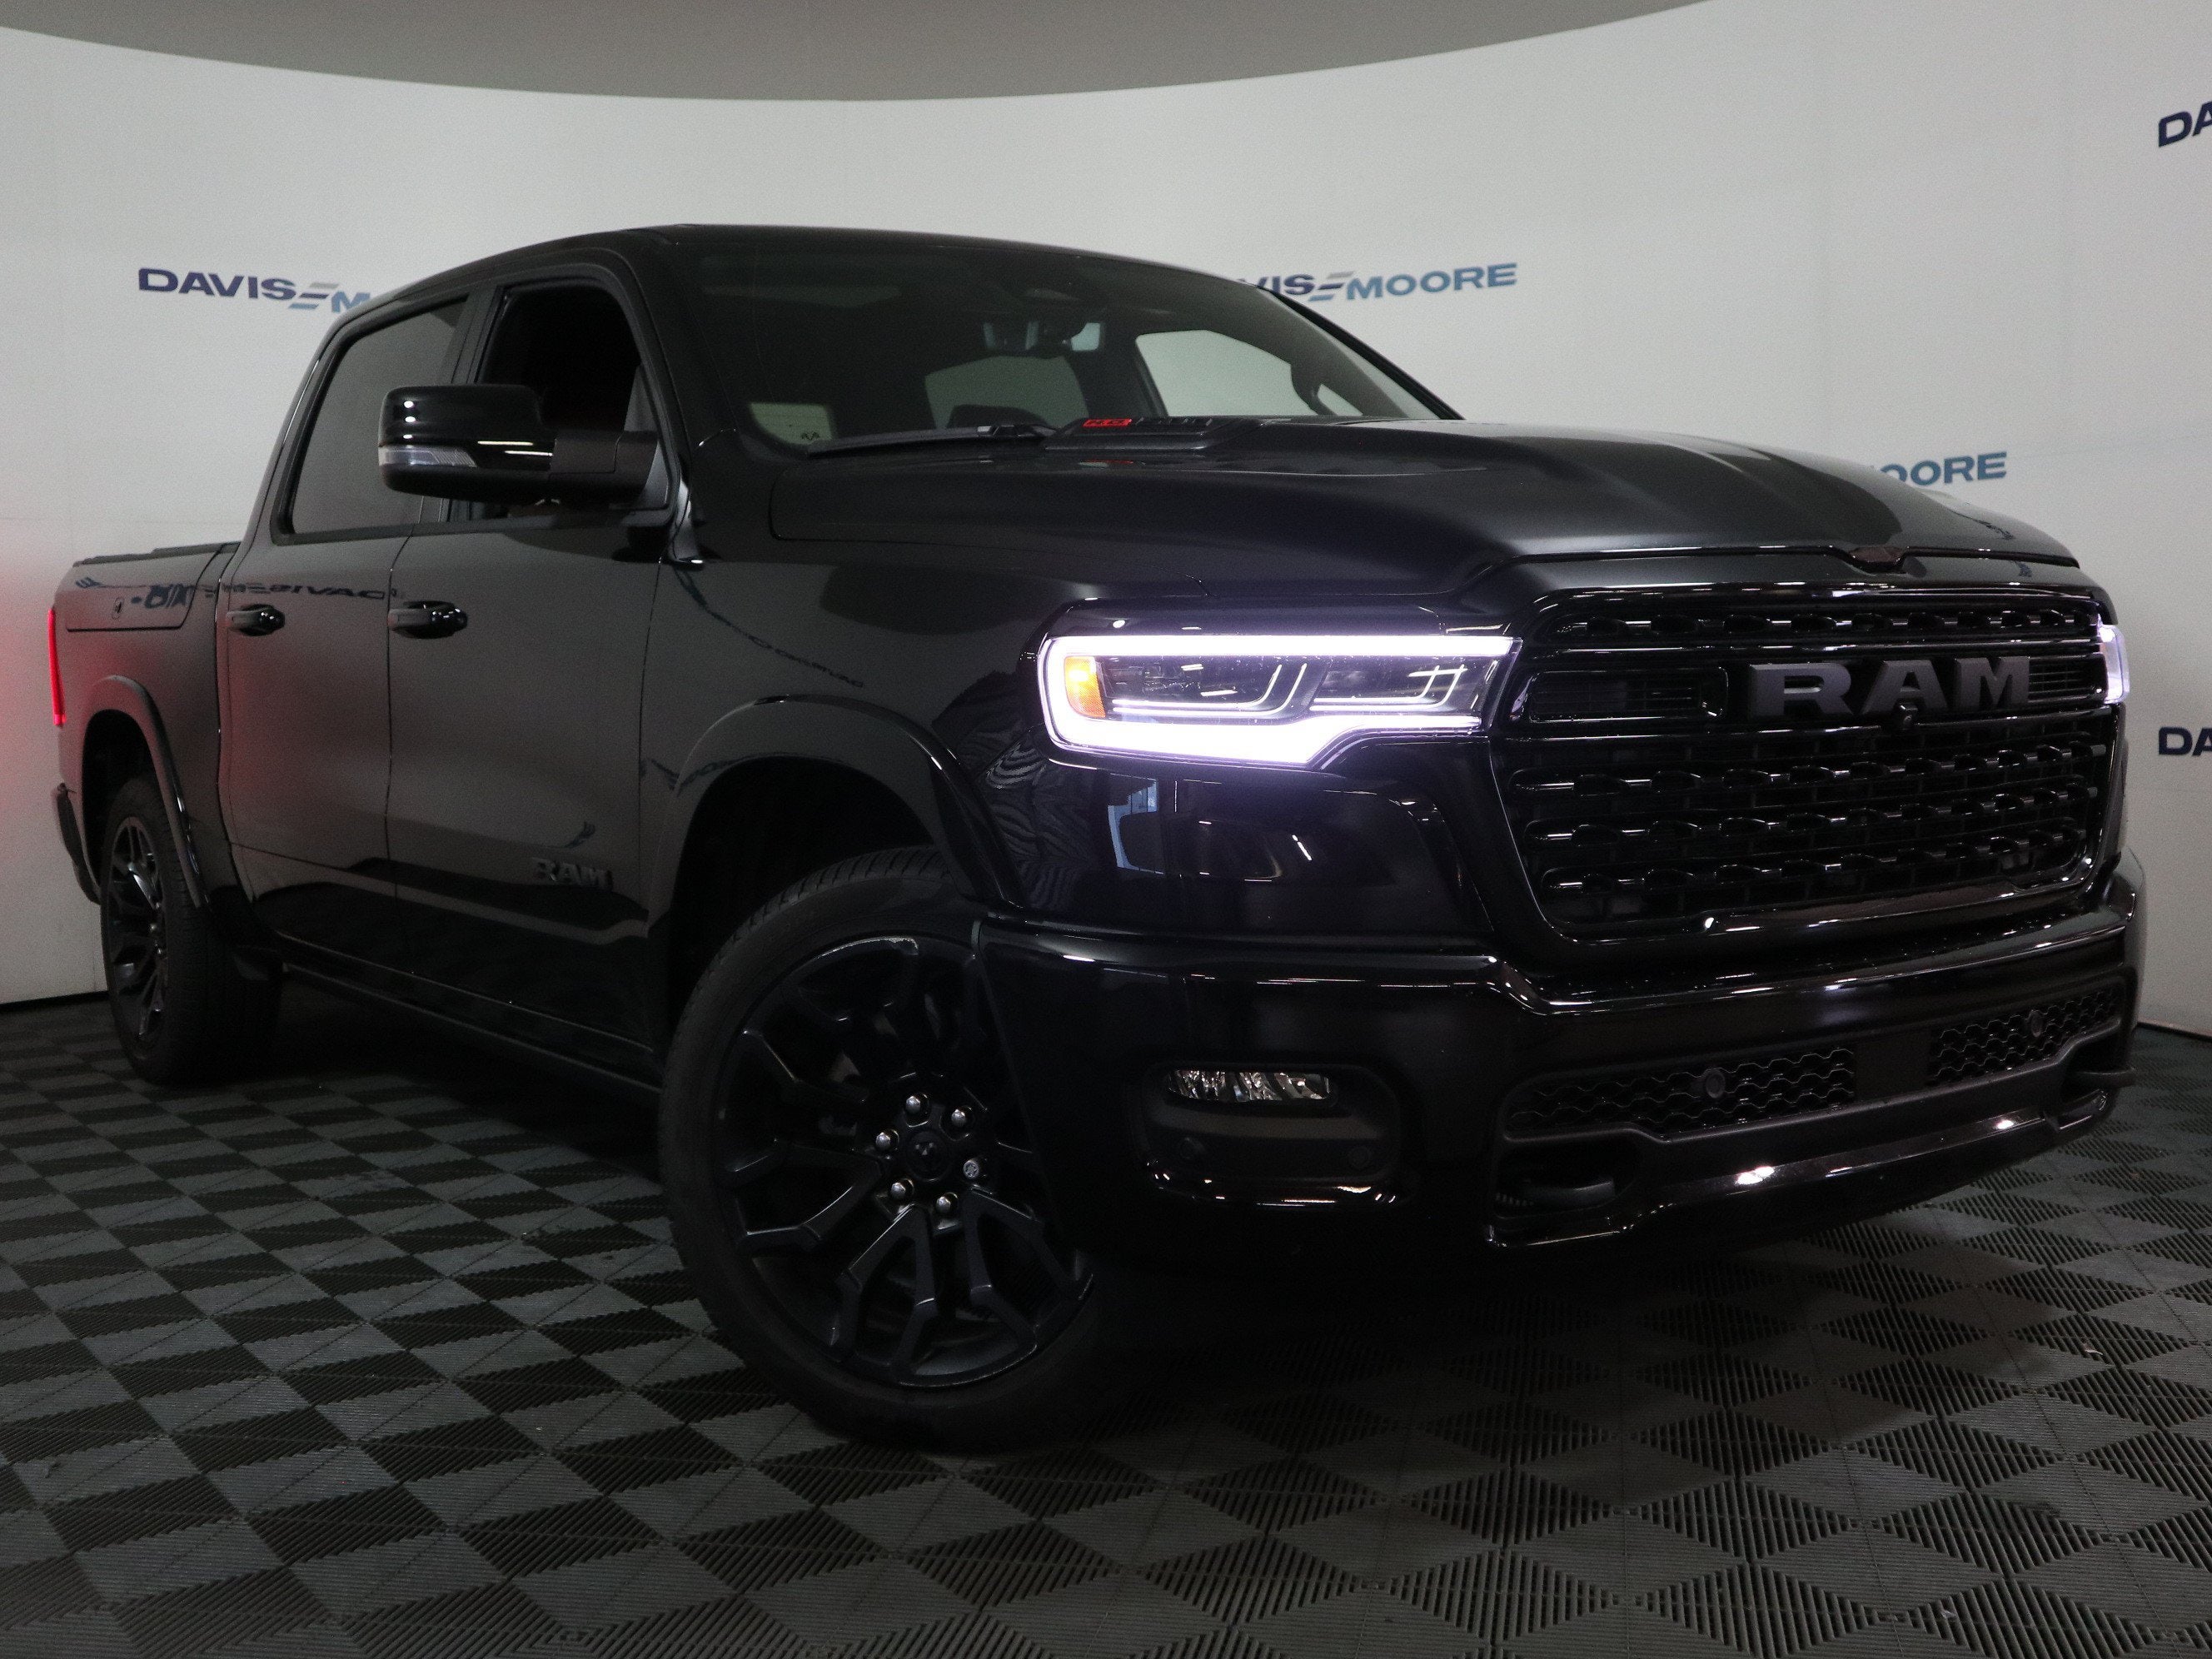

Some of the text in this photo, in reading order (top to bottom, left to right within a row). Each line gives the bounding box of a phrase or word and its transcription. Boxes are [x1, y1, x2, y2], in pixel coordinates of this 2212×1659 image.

[138, 267, 296, 301] DAVIS
[1346, 262, 1517, 301] MOORE
[1749, 655, 2030, 716] RAM
[531, 856, 611, 891] RAM
